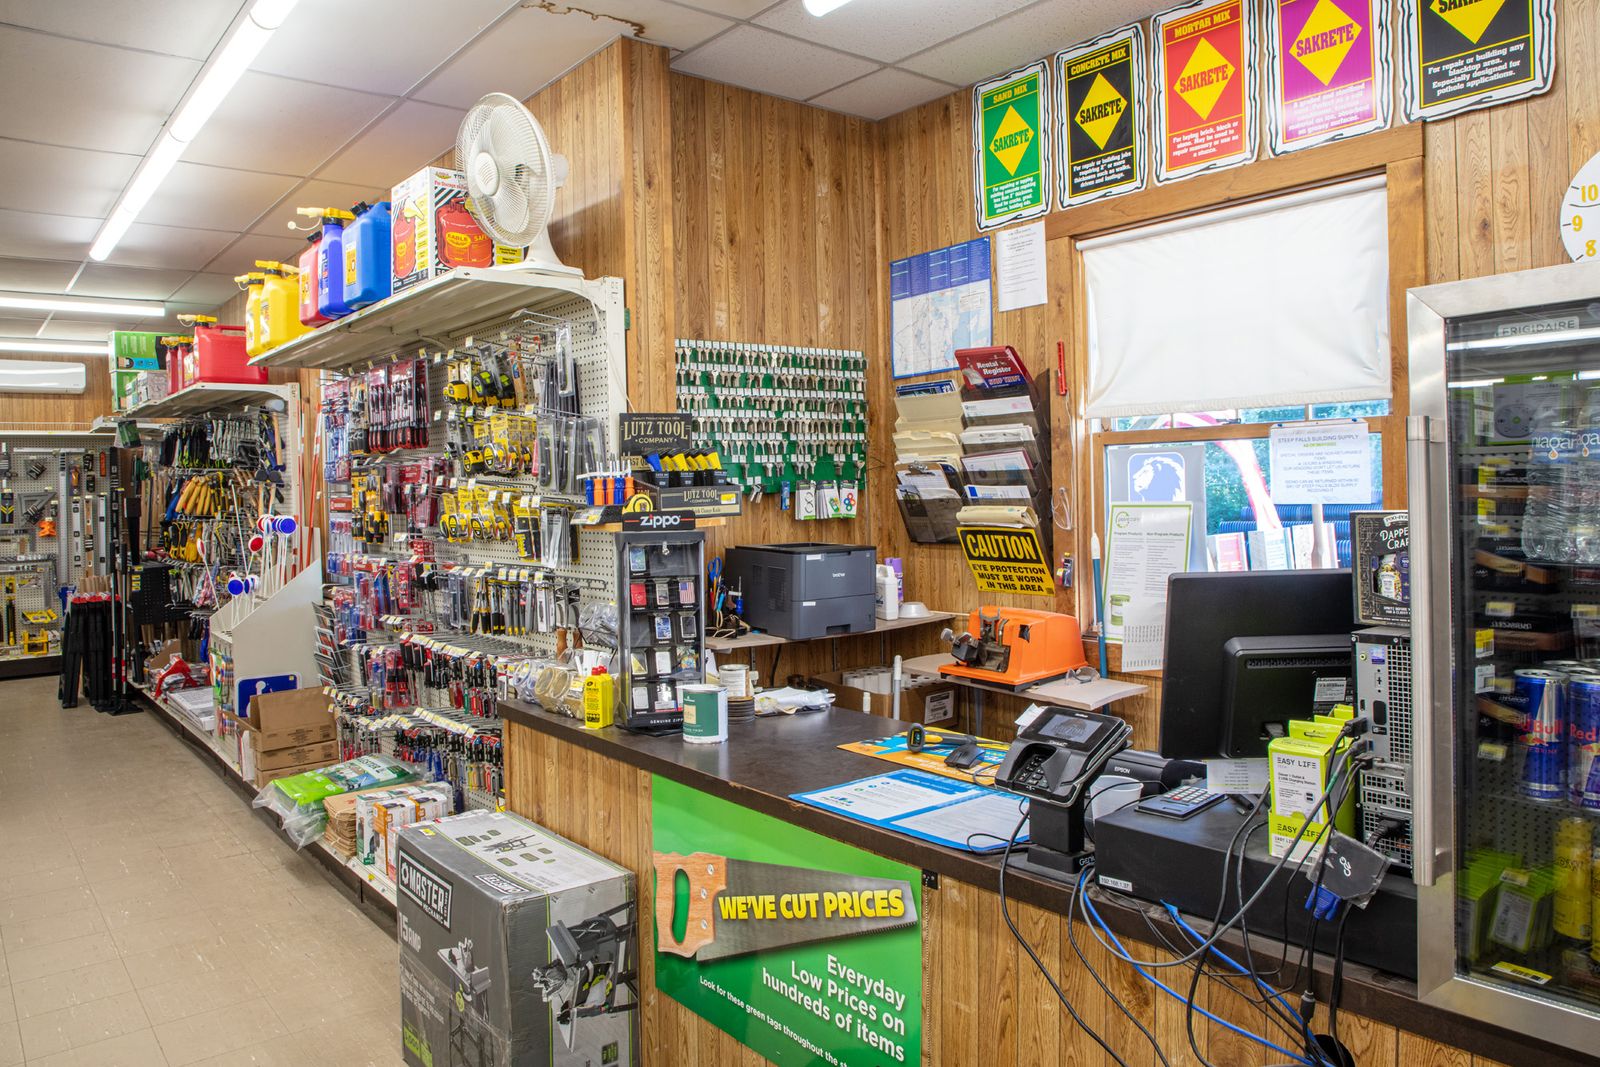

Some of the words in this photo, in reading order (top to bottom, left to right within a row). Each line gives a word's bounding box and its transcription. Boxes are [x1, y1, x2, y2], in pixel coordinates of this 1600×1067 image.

[1174, 17, 1211, 38] MORTAR
[1213, 9, 1231, 24] MIX
[1296, 23, 1355, 58] SAKRETE
[1071, 53, 1110, 75] CONCRETE
[1112, 47, 1127, 61] MIX
[1428, 67, 1440, 75] For
[1442, 59, 1464, 71] repair
[1476, 47, 1508, 61] building
[1509, 43, 1525, 53] any
[1448, 62, 1481, 77] blacktop
[1483, 58, 1503, 67] area.
[1180, 63, 1229, 94] SAKRETE
[1432, 73, 1471, 89] Especially
[1472, 63, 1508, 78] designed
[1509, 61, 1521, 69] for
[1437, 83, 1464, 97] pothole
[1466, 71, 1516, 88] applications.
[993, 89, 1012, 103] SAND
[1014, 83, 1028, 96] MIX
[1079, 98, 1123, 125] SAKRETE
[993, 128, 1030, 153] SAKRETE
[1581, 184, 1599, 203] 10
[1572, 215, 1583, 232] 9
[1586, 240, 1597, 257] 8
[1502, 320, 1575, 336] FRIGIDAIRE
[976, 361, 999, 369] Rental
[983, 367, 1011, 375] Register
[624, 421, 653, 440] LUTZ
[657, 421, 688, 440] TOOL
[683, 490, 700, 502] LUTZ
[702, 489, 720, 500] TOOL
[640, 514, 679, 528] zippo
[1380, 527, 1408, 541] DAPPE
[966, 534, 1037, 560] CAUTION
[972, 563, 989, 571] EYE
[990, 564, 1046, 575] PROTECTION
[978, 572, 1000, 580] MUST
[1002, 574, 1014, 582] BE
[1016, 575, 1044, 583] WORN
[997, 582, 1017, 590] THIS
[1020, 584, 1044, 592] AREA
[1534, 720, 1563, 734] Bull
[1571, 723, 1596, 741] Red
[1114, 766, 1130, 774] EPSON
[1277, 757, 1295, 765] EASY
[1298, 761, 1316, 769] LIFE
[1277, 824, 1297, 834] EASY
[409, 866, 445, 914] MASTER
[718, 893, 777, 920] WE'VE
[780, 893, 819, 919] CUT
[823, 889, 905, 918] PRICES
[827, 954, 906, 1011] Everyday
[700, 976, 716, 991] Look
[716, 985, 726, 997] for
[727, 990, 745, 1009] these
[745, 1003, 766, 1023] green
[766, 1015, 782, 1032] tags
[791, 960, 822, 991] Low
[827, 979, 877, 1021] Prices
[882, 1012, 905, 1036] on
[762, 967, 830, 1021] hundreds
[835, 1012, 852, 1032] of
[856, 1019, 904, 1062] items
